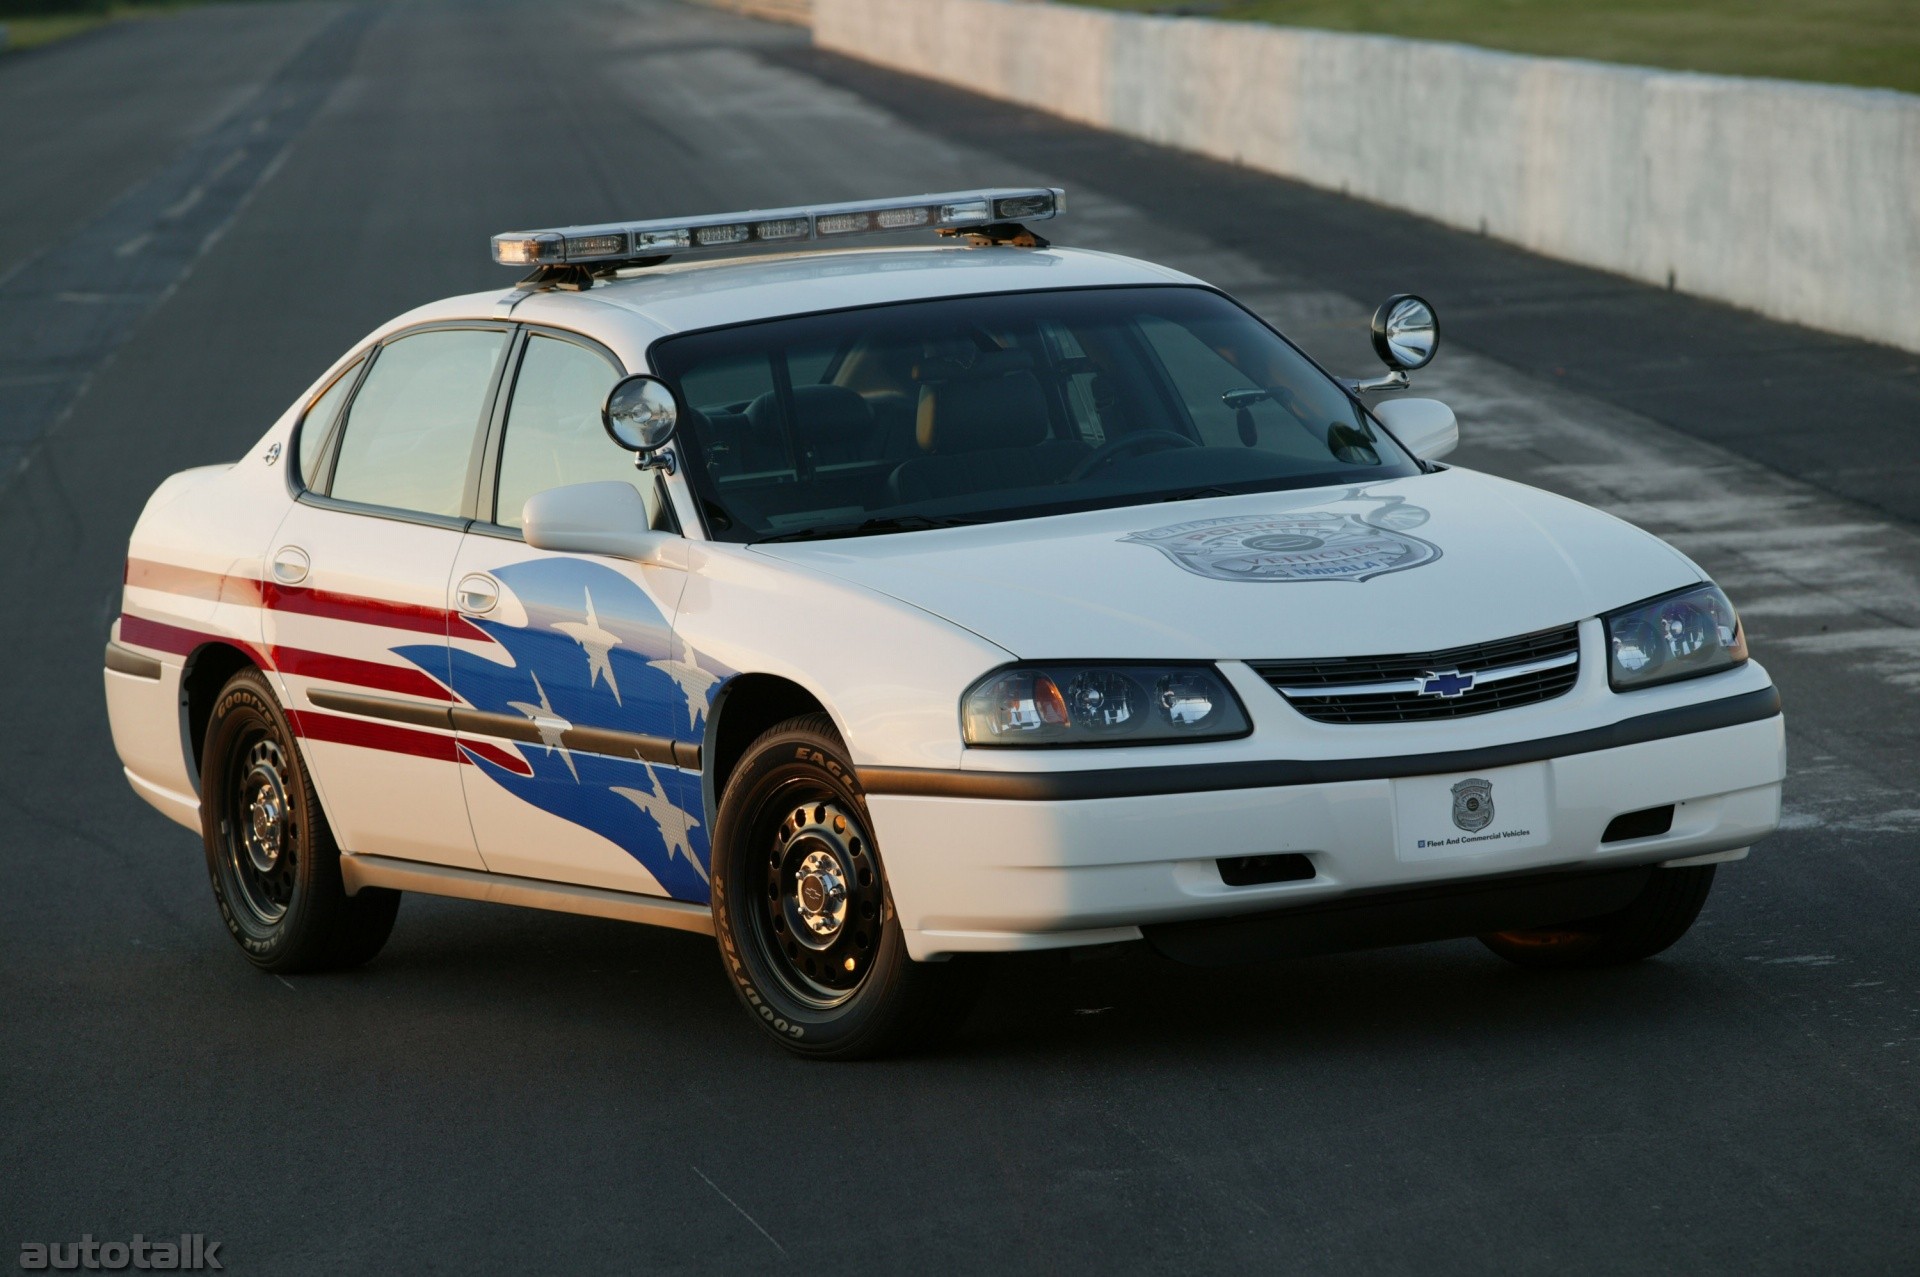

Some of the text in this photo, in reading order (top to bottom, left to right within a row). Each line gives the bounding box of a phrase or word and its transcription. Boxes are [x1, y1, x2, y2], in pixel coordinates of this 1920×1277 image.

[1186, 521, 1321, 541] POLICE
[1241, 544, 1381, 565] VEHICLES
[1295, 561, 1380, 576] IMPALA
[218, 691, 289, 761] GOODYEAR
[795, 746, 866, 812] EAGLE
[1427, 840, 1444, 848] Fleet
[1446, 837, 1460, 845] And
[1461, 833, 1501, 843] Commercial
[1502, 829, 1530, 838] Vehicles
[715, 875, 805, 1039] GOODYEAR
